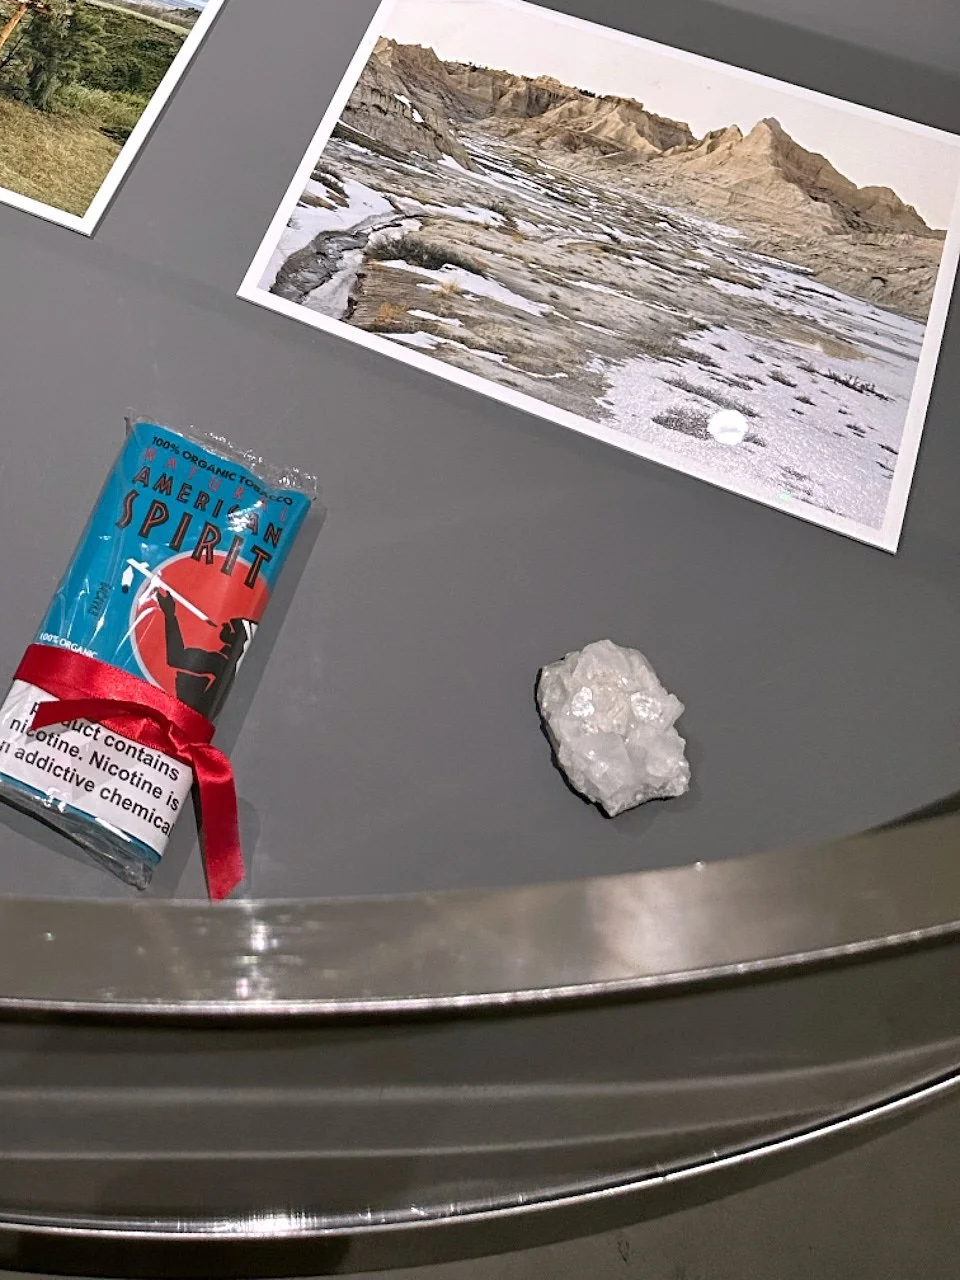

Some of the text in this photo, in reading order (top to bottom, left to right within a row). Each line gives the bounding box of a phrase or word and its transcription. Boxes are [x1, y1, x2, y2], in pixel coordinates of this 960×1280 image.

[152, 436, 180, 455] 100%
[182, 450, 236, 481] ORGANIC
[115, 489, 272, 589] SPIRIT
[14, 745, 95, 792] addictive
[89, 751, 163, 799] Nicotine
[165, 791, 180, 811] is
[104, 734, 180, 781] contains
